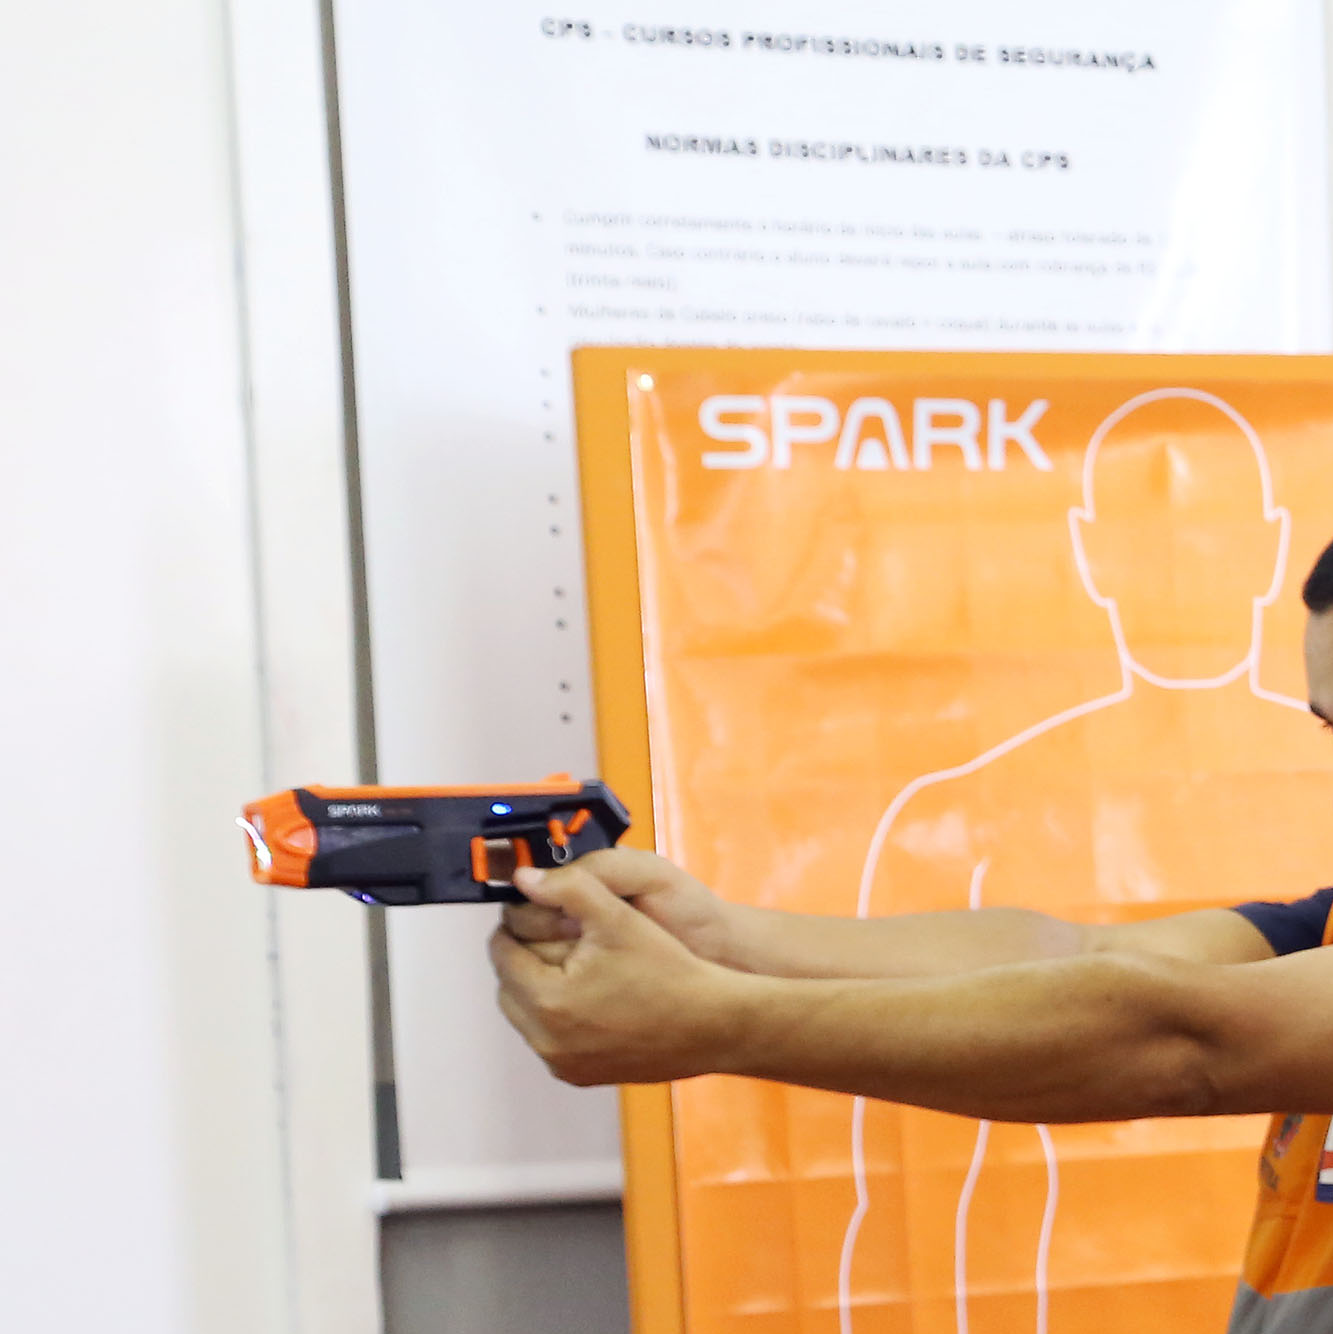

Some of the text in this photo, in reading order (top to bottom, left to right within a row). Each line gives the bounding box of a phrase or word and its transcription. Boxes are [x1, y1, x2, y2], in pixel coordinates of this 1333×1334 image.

[541, 18, 592, 38] CPS
[622, 23, 731, 46] CURSOS
[743, 31, 944, 59] PROFISSIONAIS
[955, 43, 987, 62] DE
[998, 47, 1156, 72] SEGURANÇA
[646, 134, 1072, 170] NORMAS DISCIPLINARES DA CPS
[700, 394, 1053, 471] SPARK
[327, 803, 382, 819] SPARK
